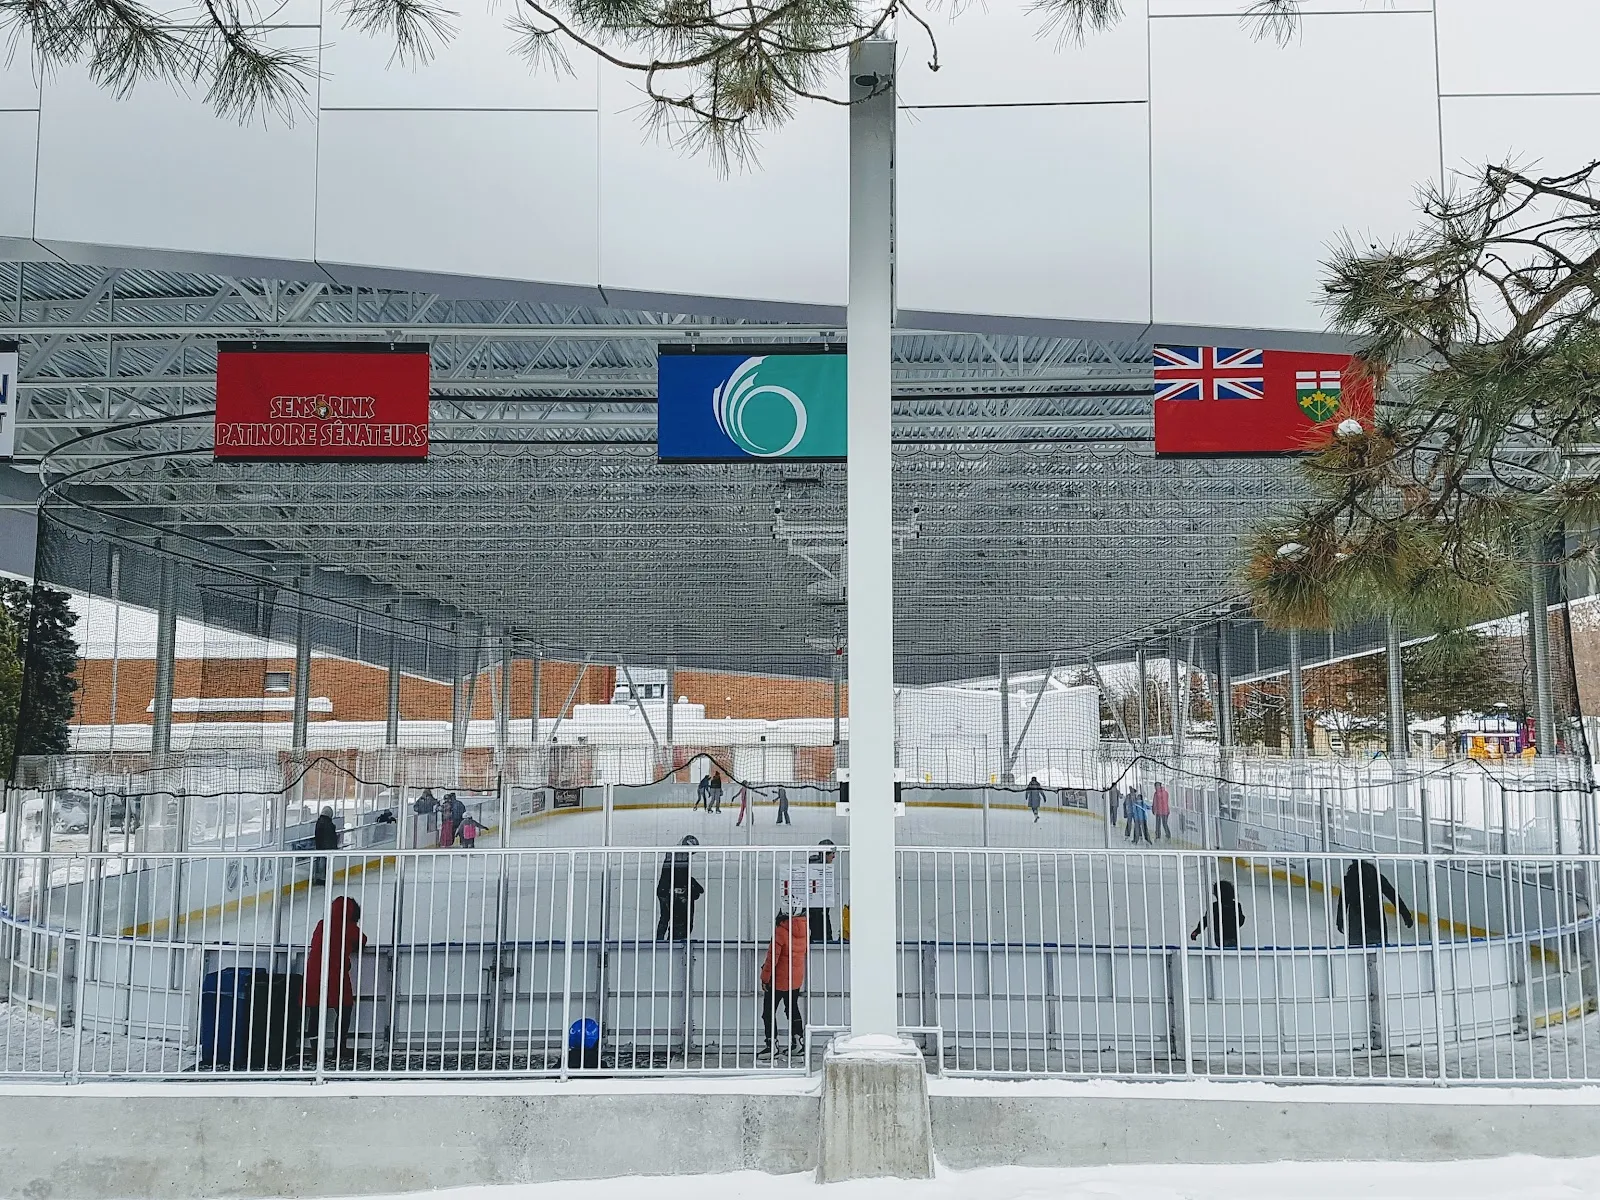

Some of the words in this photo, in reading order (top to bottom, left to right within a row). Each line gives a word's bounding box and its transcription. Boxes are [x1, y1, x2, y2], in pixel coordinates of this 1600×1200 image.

[270, 396, 317, 419] SENS
[329, 396, 375, 419] RINK
[217, 423, 317, 446] PATINOIRE
[320, 420, 427, 447] SÉNATEURS
